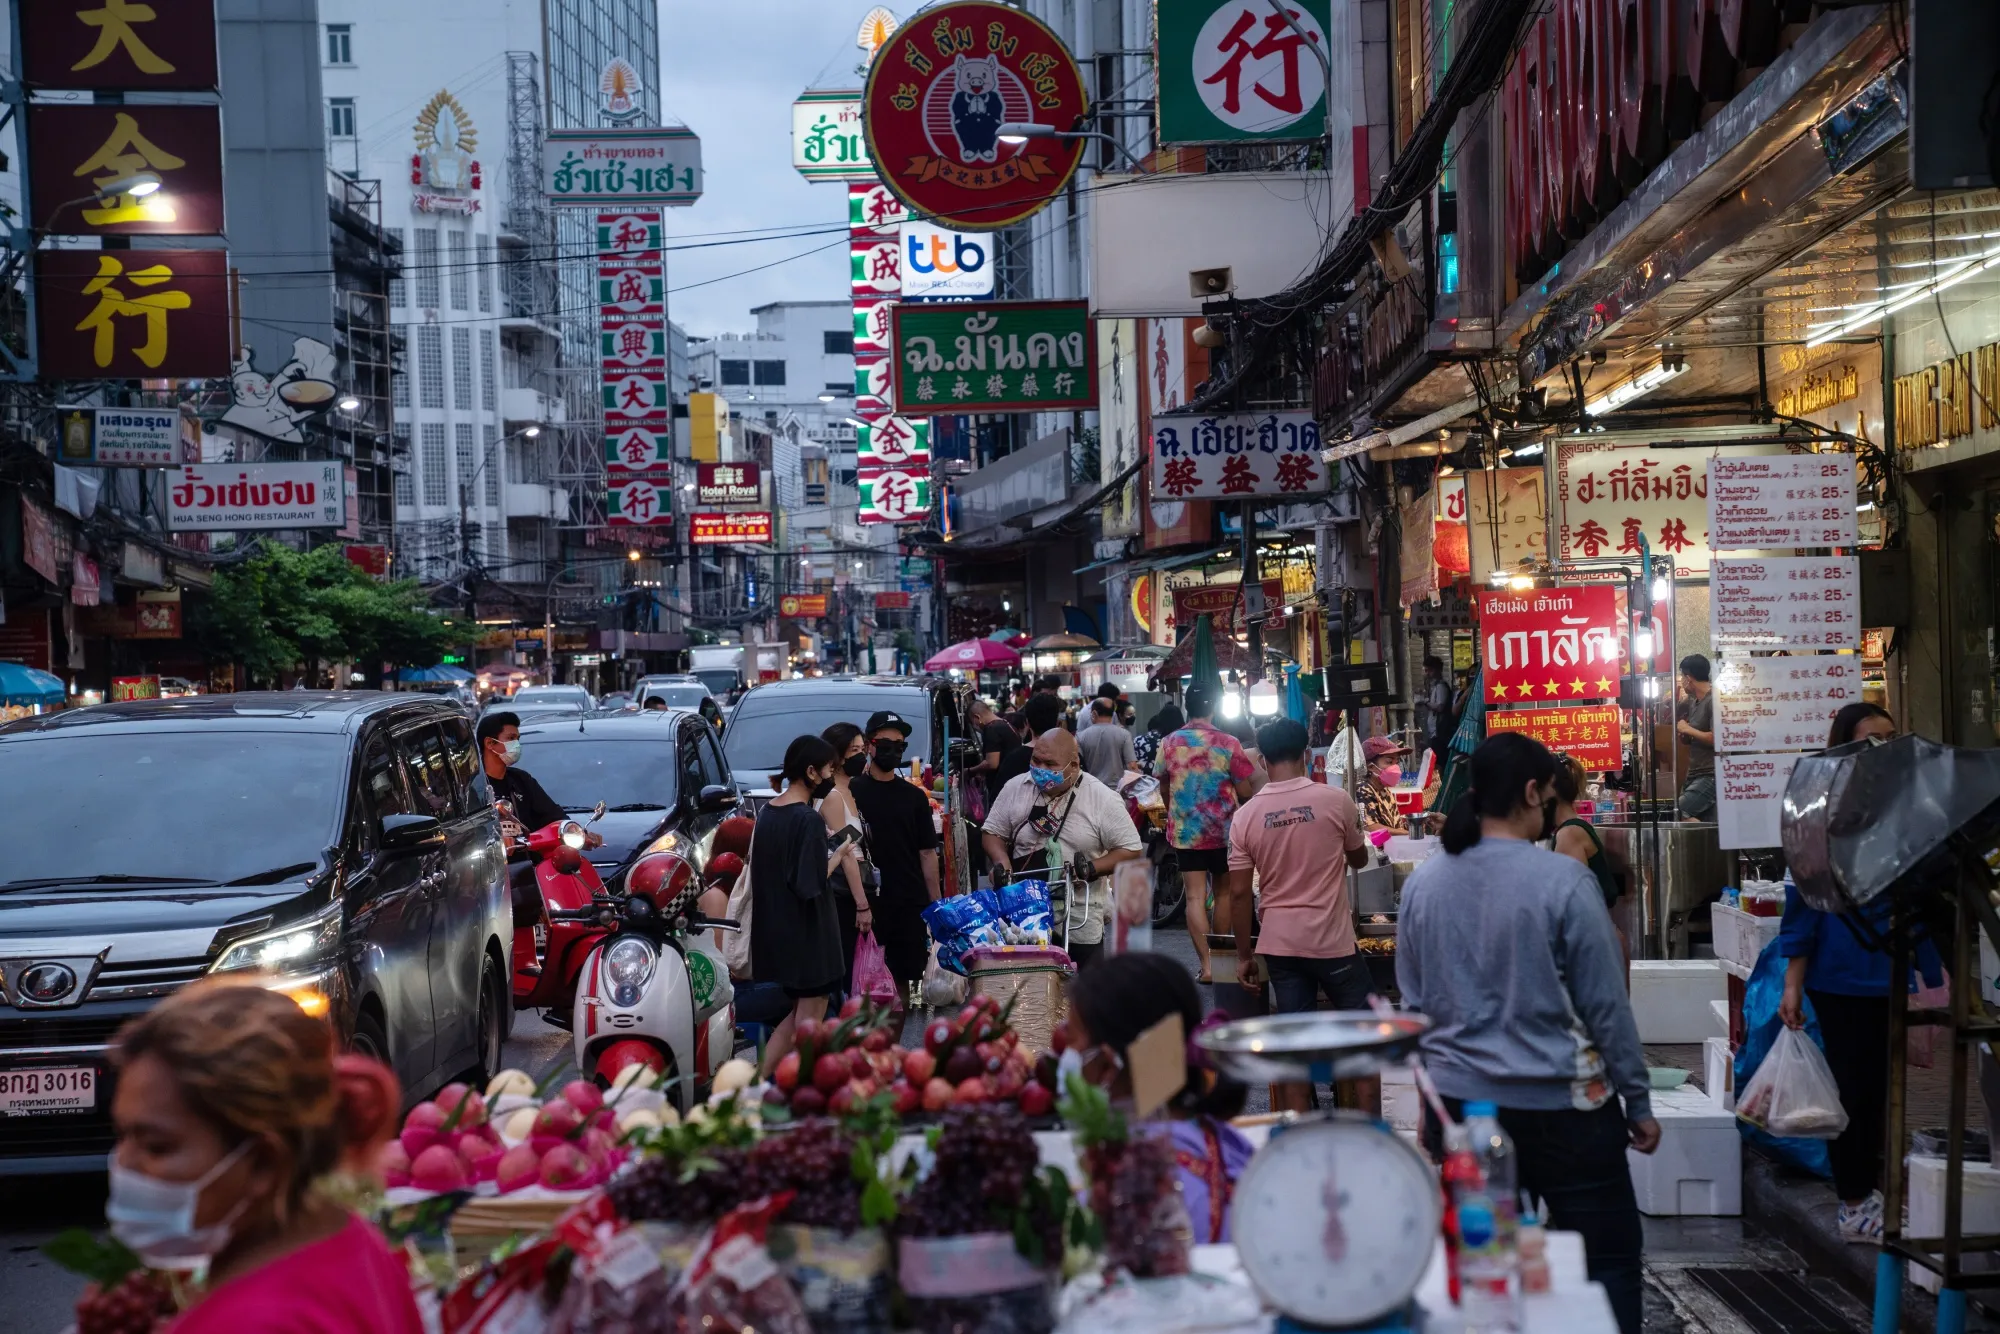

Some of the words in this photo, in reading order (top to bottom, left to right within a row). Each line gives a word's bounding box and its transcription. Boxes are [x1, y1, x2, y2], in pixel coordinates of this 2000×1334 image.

[1203, 8, 1319, 115] 行
[553, 151, 694, 193] ฮั่วเซ่งเฮง
[908, 234, 985, 273] ttb
[954, 281, 985, 289] Change
[905, 311, 1084, 373] ฉ.มั่นคง
[1821, 465, 1849, 477] 25.-
[172, 467, 316, 508] ฮั่วเซ่งฮง
[700, 486, 726, 496] Hotel
[729, 485, 758, 497] Royal
[1821, 487, 1849, 499] 25.-
[173, 515, 194, 523] HUA
[196, 514, 222, 522] SENG
[225, 513, 252, 522] HONG
[254, 512, 316, 521] RESTAURANT
[1822, 508, 1850, 520] 25.-
[1823, 530, 1851, 542] 25-
[1717, 573, 1740, 581] Lotus
[1824, 567, 1852, 579] 25.-
[1824, 589, 1852, 601] 25.-
[1534, 594, 1573, 613] เจ้าเก่า
[1825, 611, 1853, 623] 25.-
[1825, 632, 1853, 644] 25.-
[1826, 665, 1854, 677] 40.-
[1827, 687, 1855, 699] 40.-
[1828, 709, 1838, 720] 4
[1577, 742, 1610, 750] Chestnut
[1597, 758, 1615, 767] 日本
[1723, 772, 1741, 780] Jelly
[1272, 817, 1308, 829] BERETTA
[44, 1072, 91, 1091] 3016
[9, 1097, 80, 1108] กรุงเทพมหานคร
